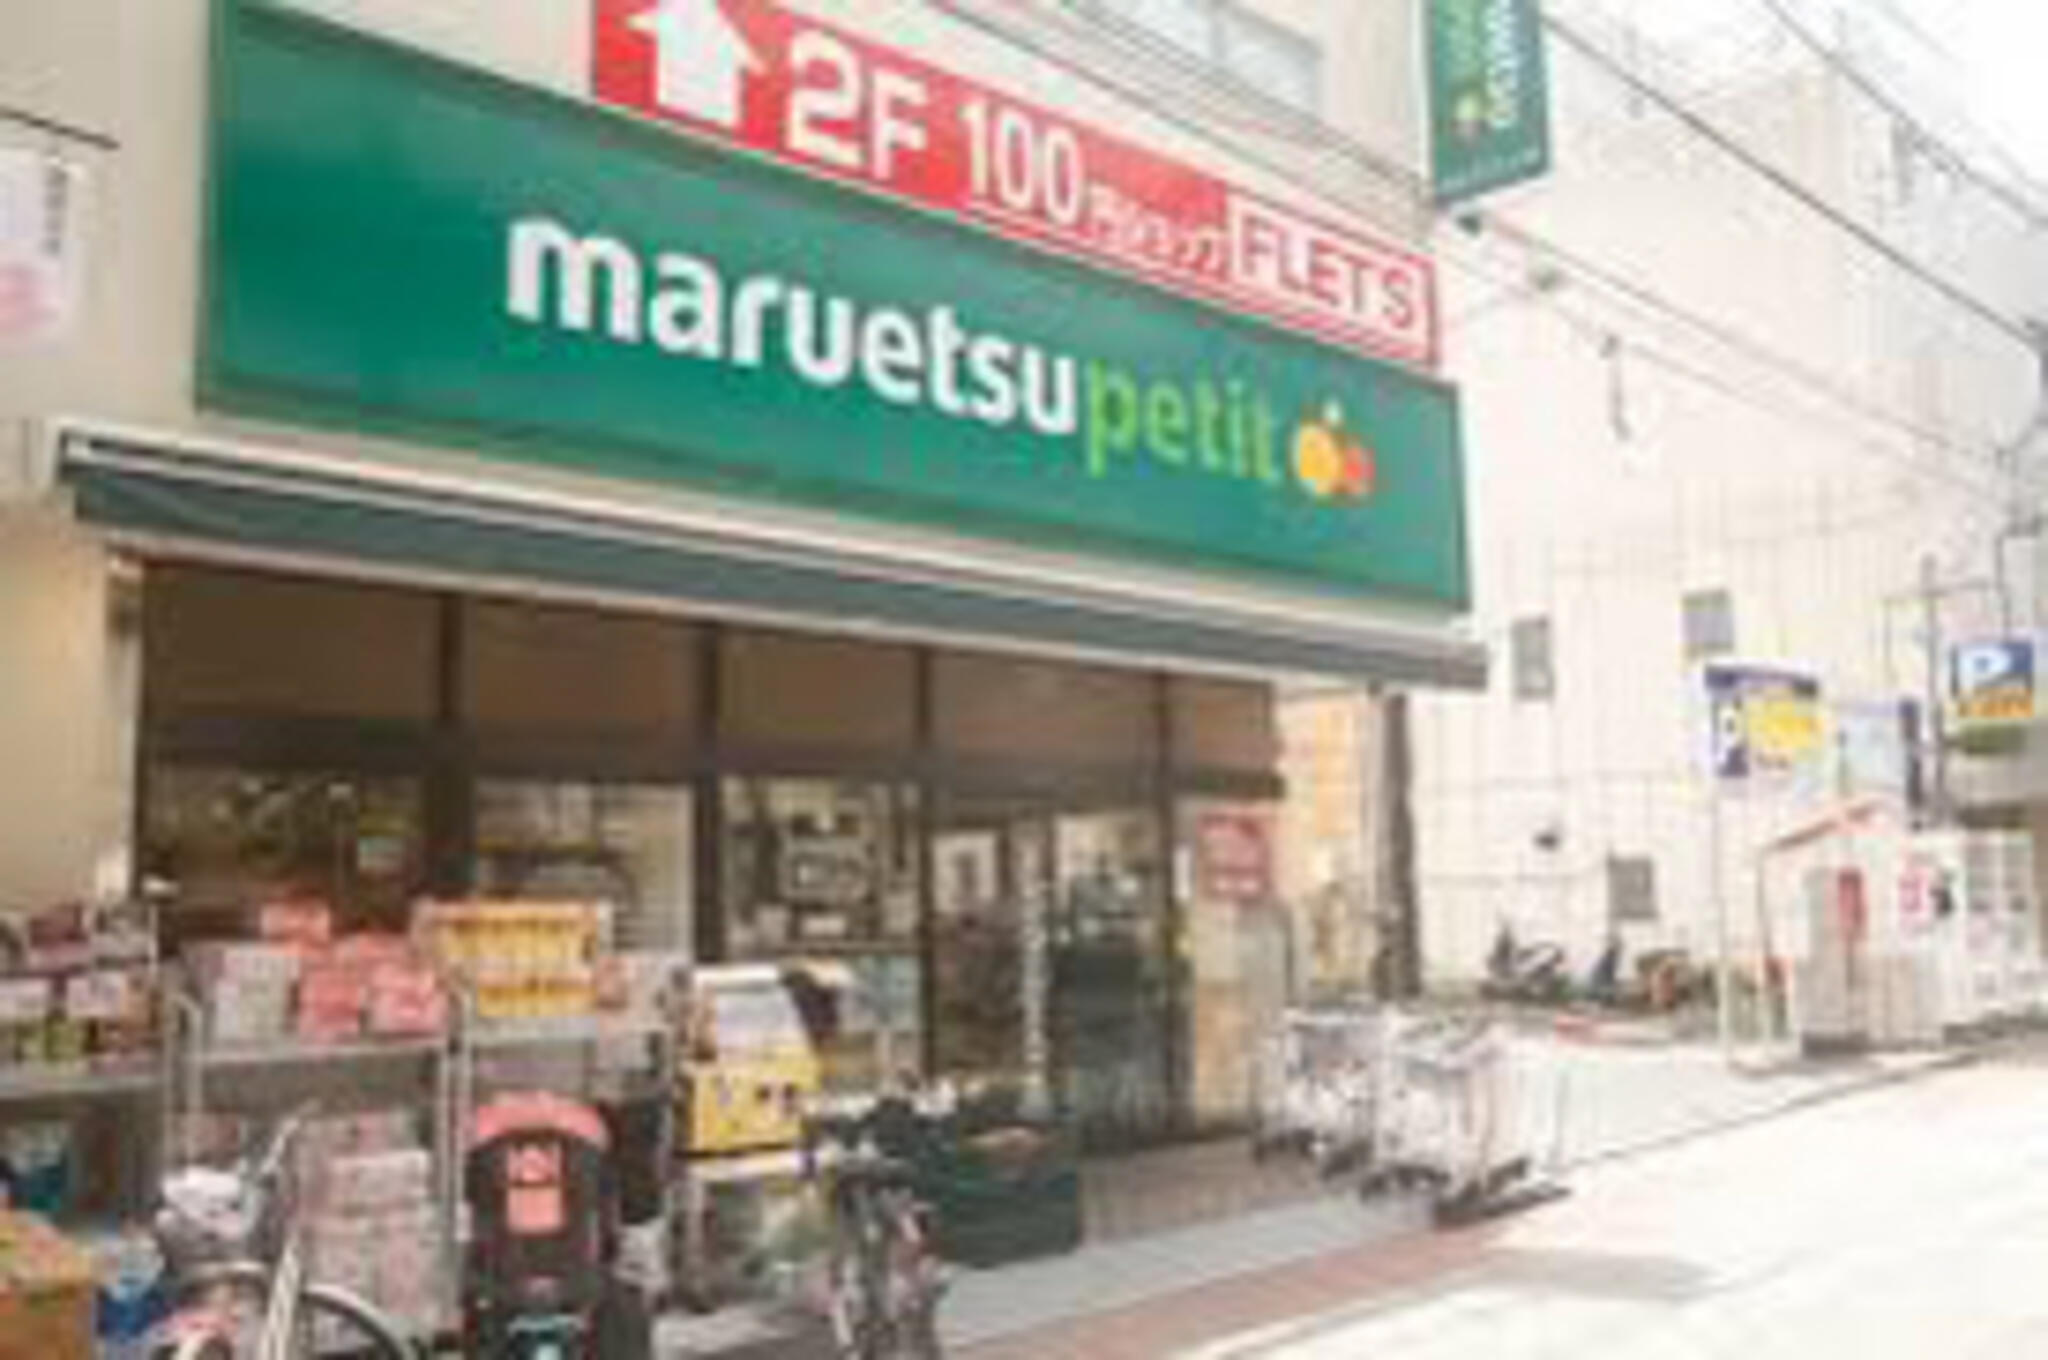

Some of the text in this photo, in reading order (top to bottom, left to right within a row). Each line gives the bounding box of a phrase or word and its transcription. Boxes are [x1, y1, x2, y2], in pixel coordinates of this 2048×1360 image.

[787, 28, 926, 181] 2F
[957, 98, 1079, 224] 100
[1241, 213, 1415, 330] FLETS
[506, 217, 1282, 482] maruetsu petit
